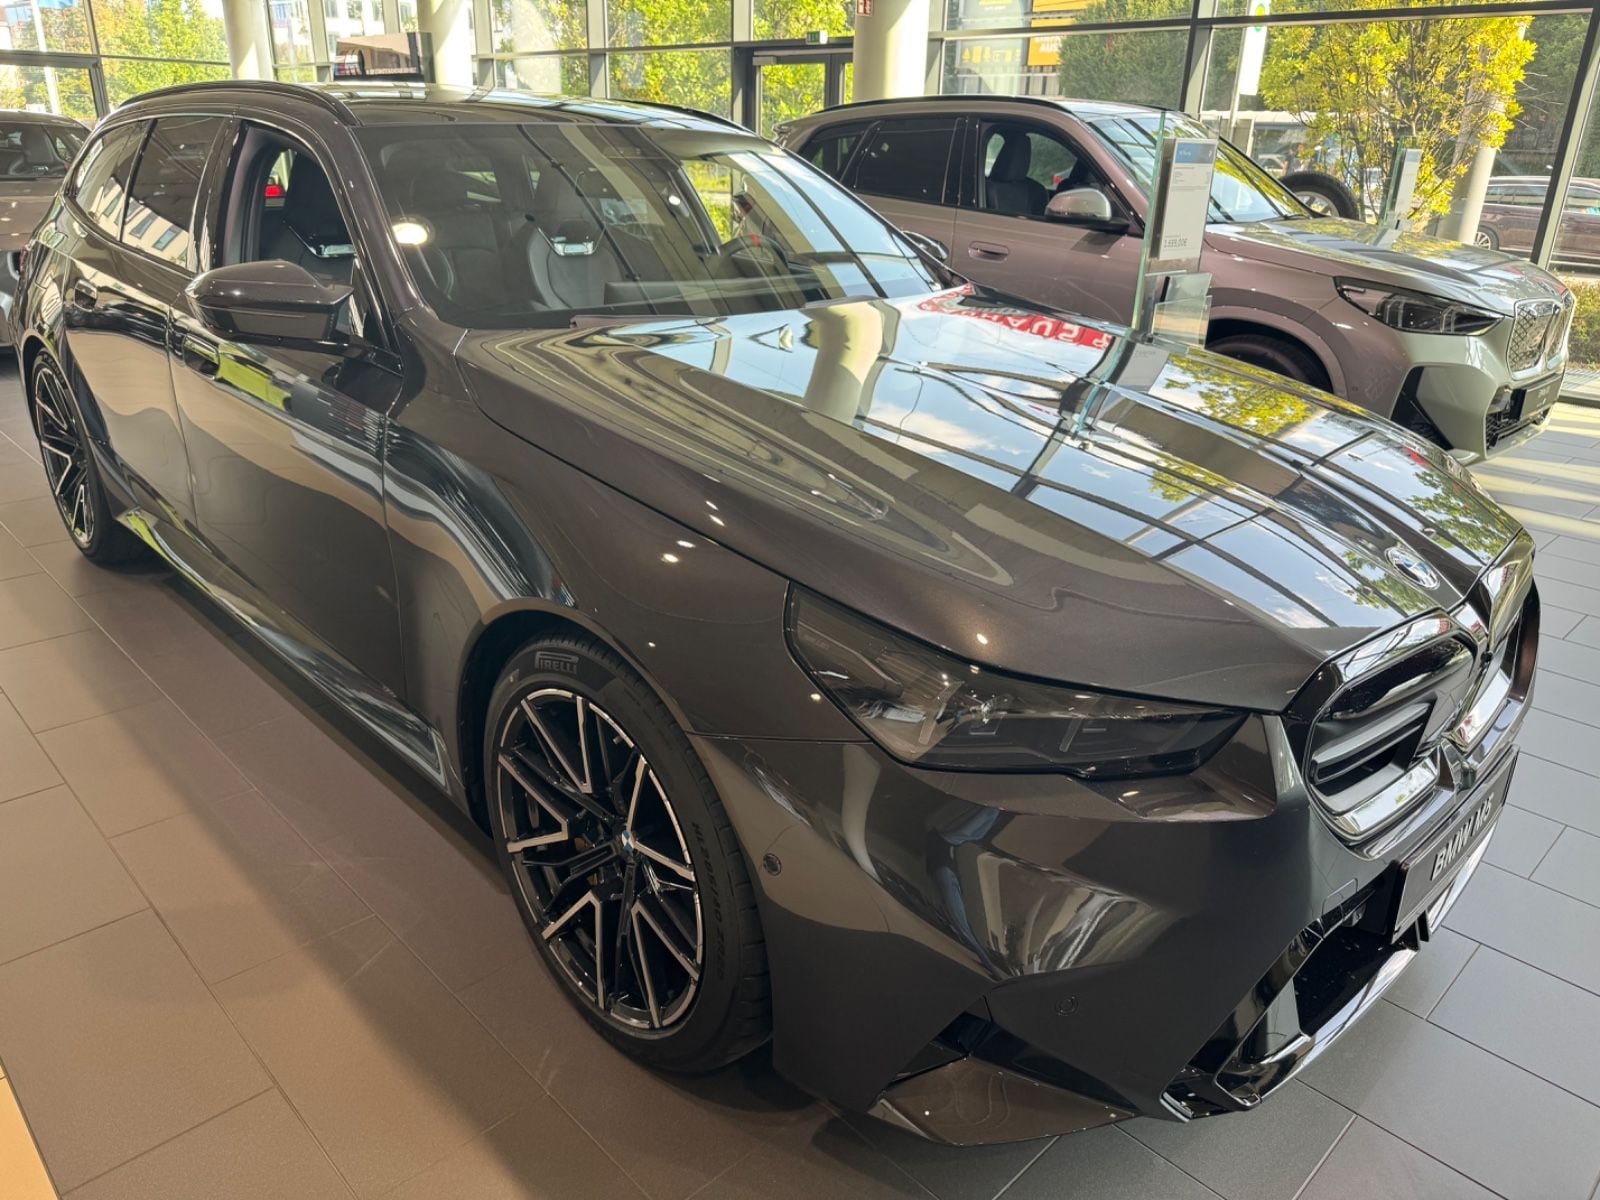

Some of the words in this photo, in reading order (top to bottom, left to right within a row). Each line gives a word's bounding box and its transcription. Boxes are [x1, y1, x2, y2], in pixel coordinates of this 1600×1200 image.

[535, 651, 579, 675] PIRELLI
[1430, 816, 1474, 881] BMW
[1470, 792, 1495, 837] M5
